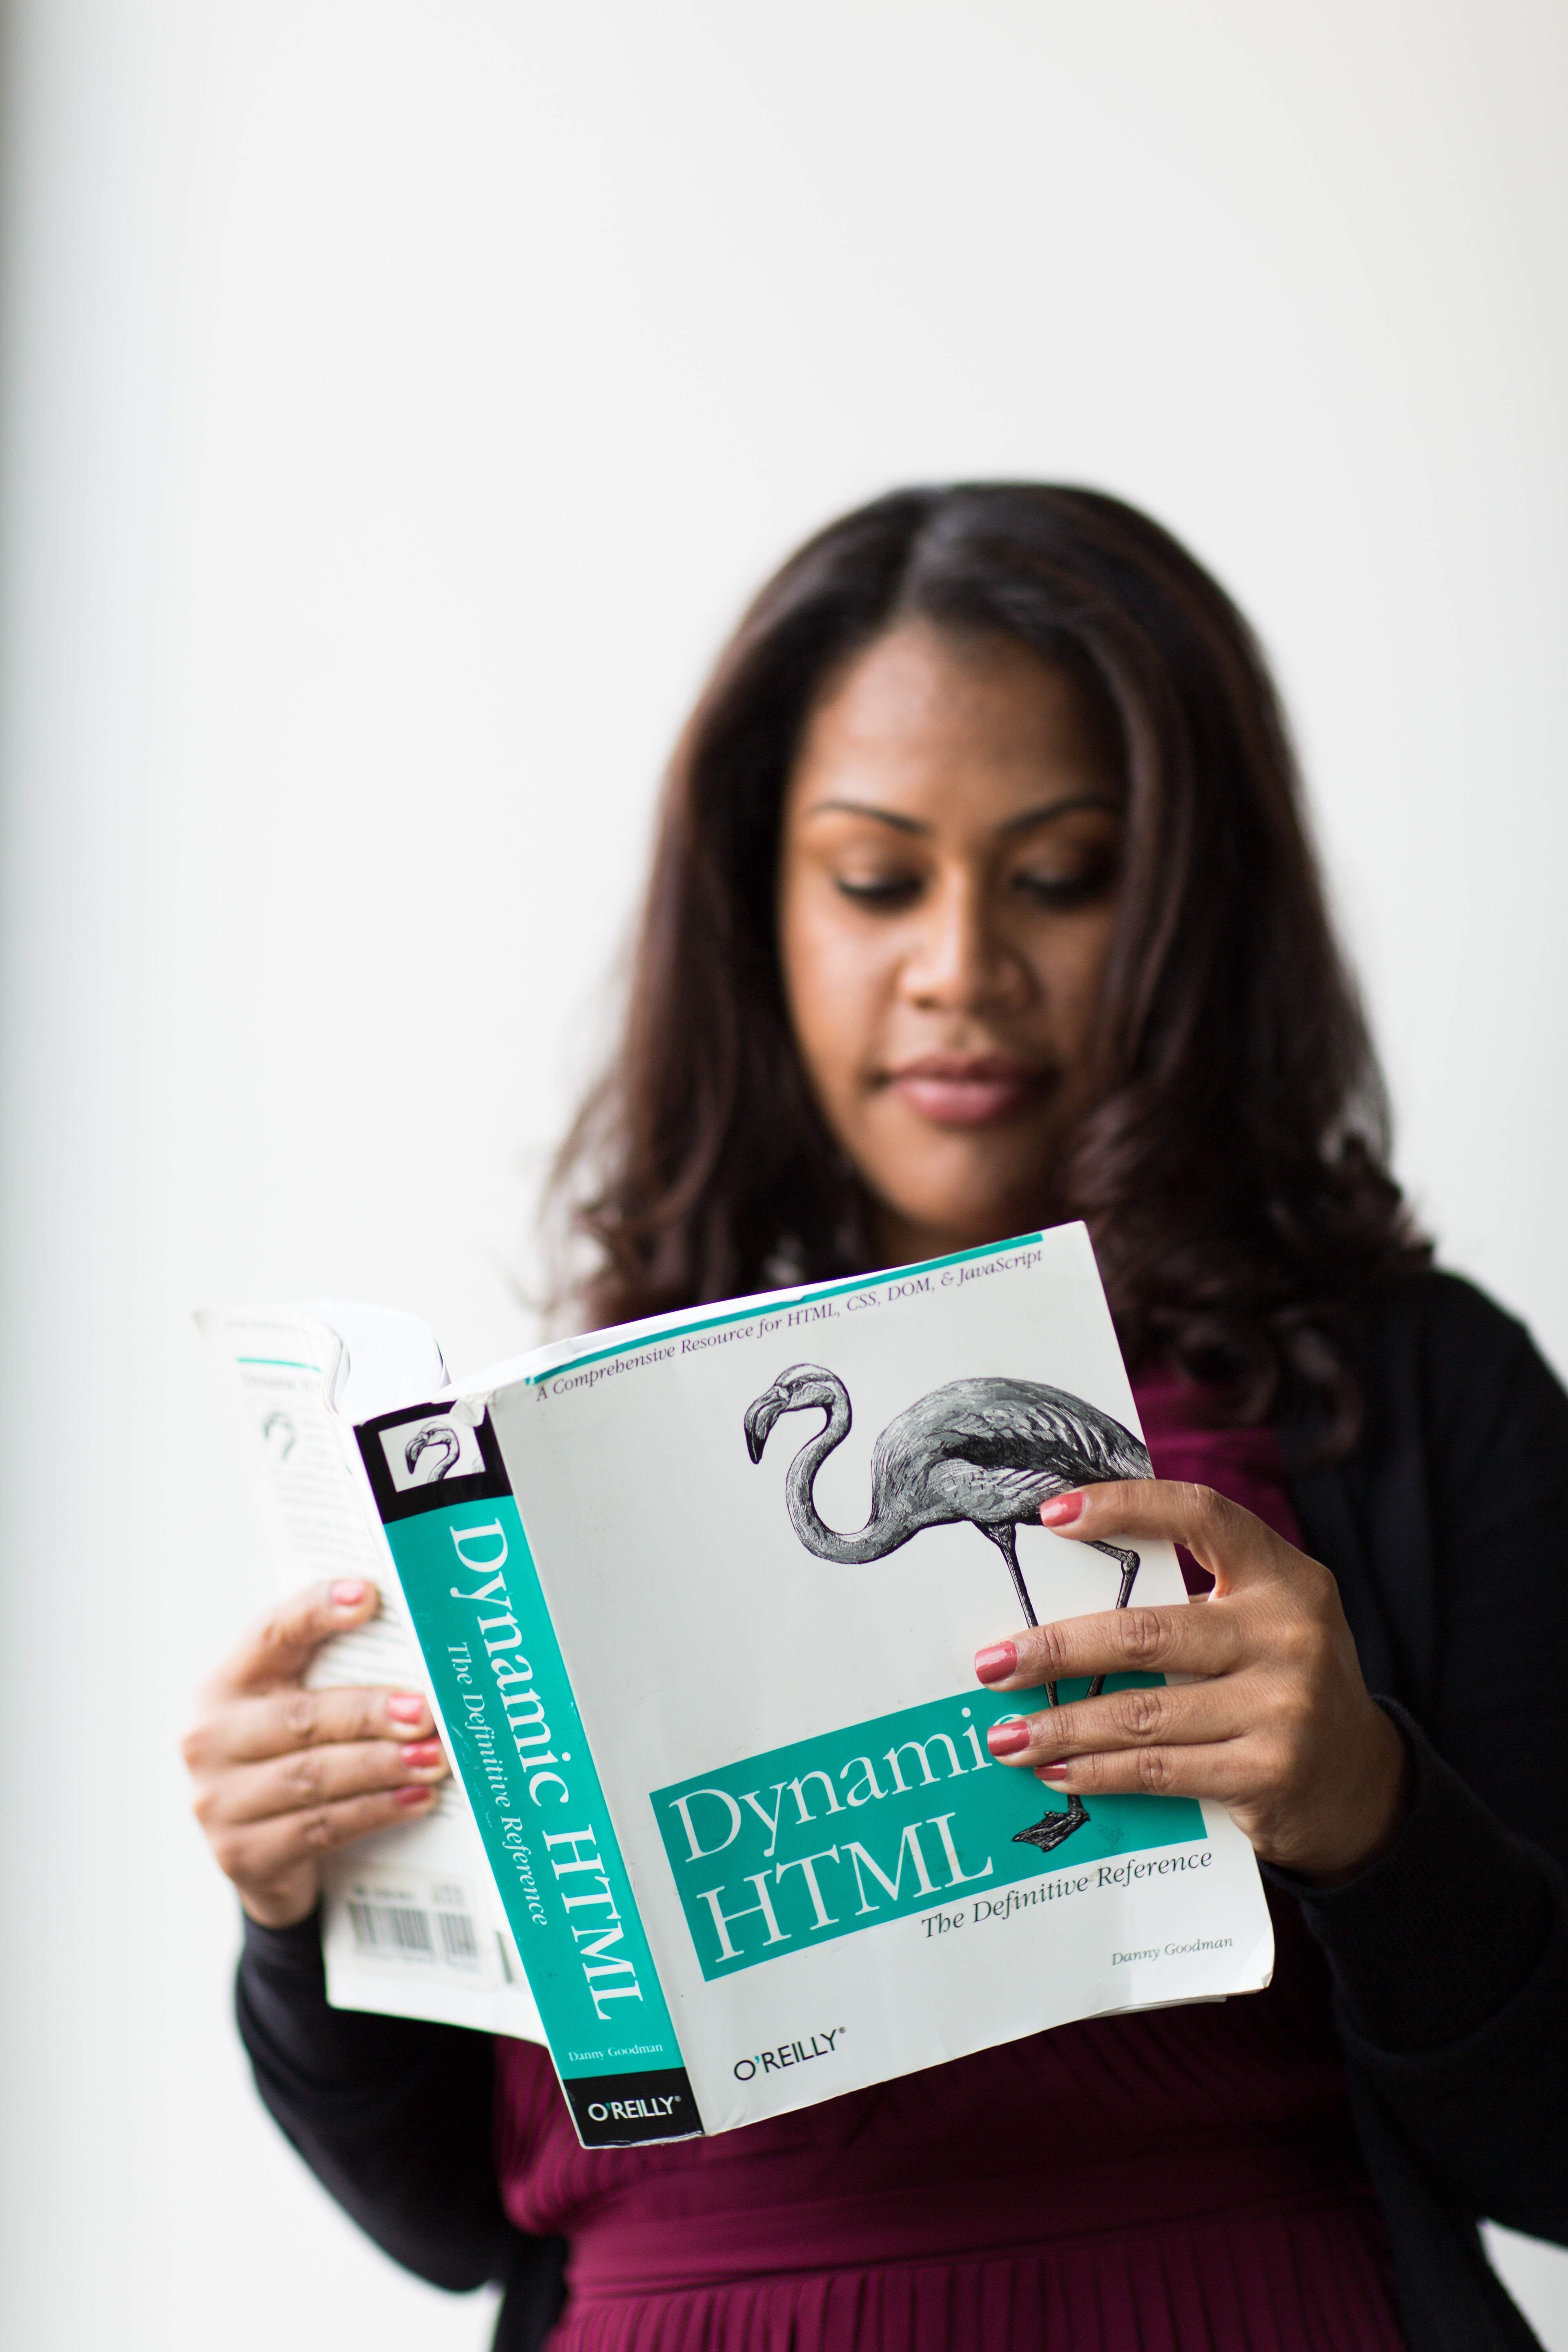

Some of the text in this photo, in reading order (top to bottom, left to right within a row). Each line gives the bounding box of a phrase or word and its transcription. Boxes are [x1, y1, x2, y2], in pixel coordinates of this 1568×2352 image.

[536, 1250, 1042, 1402] A Comprehensive Resource for HTML, CSS, DOM, & JavaScript
[448, 1642, 547, 1926] The Definitive Reference
[450, 1517, 643, 2020] Dynamic HTML
[669, 1707, 1023, 1862] Dynami
[696, 1812, 993, 1963] HTML
[922, 1851, 1212, 1938] The Definitive Reference
[1111, 1936, 1233, 1966] Danny Goodman
[568, 2042, 663, 2062] Danny Goodman
